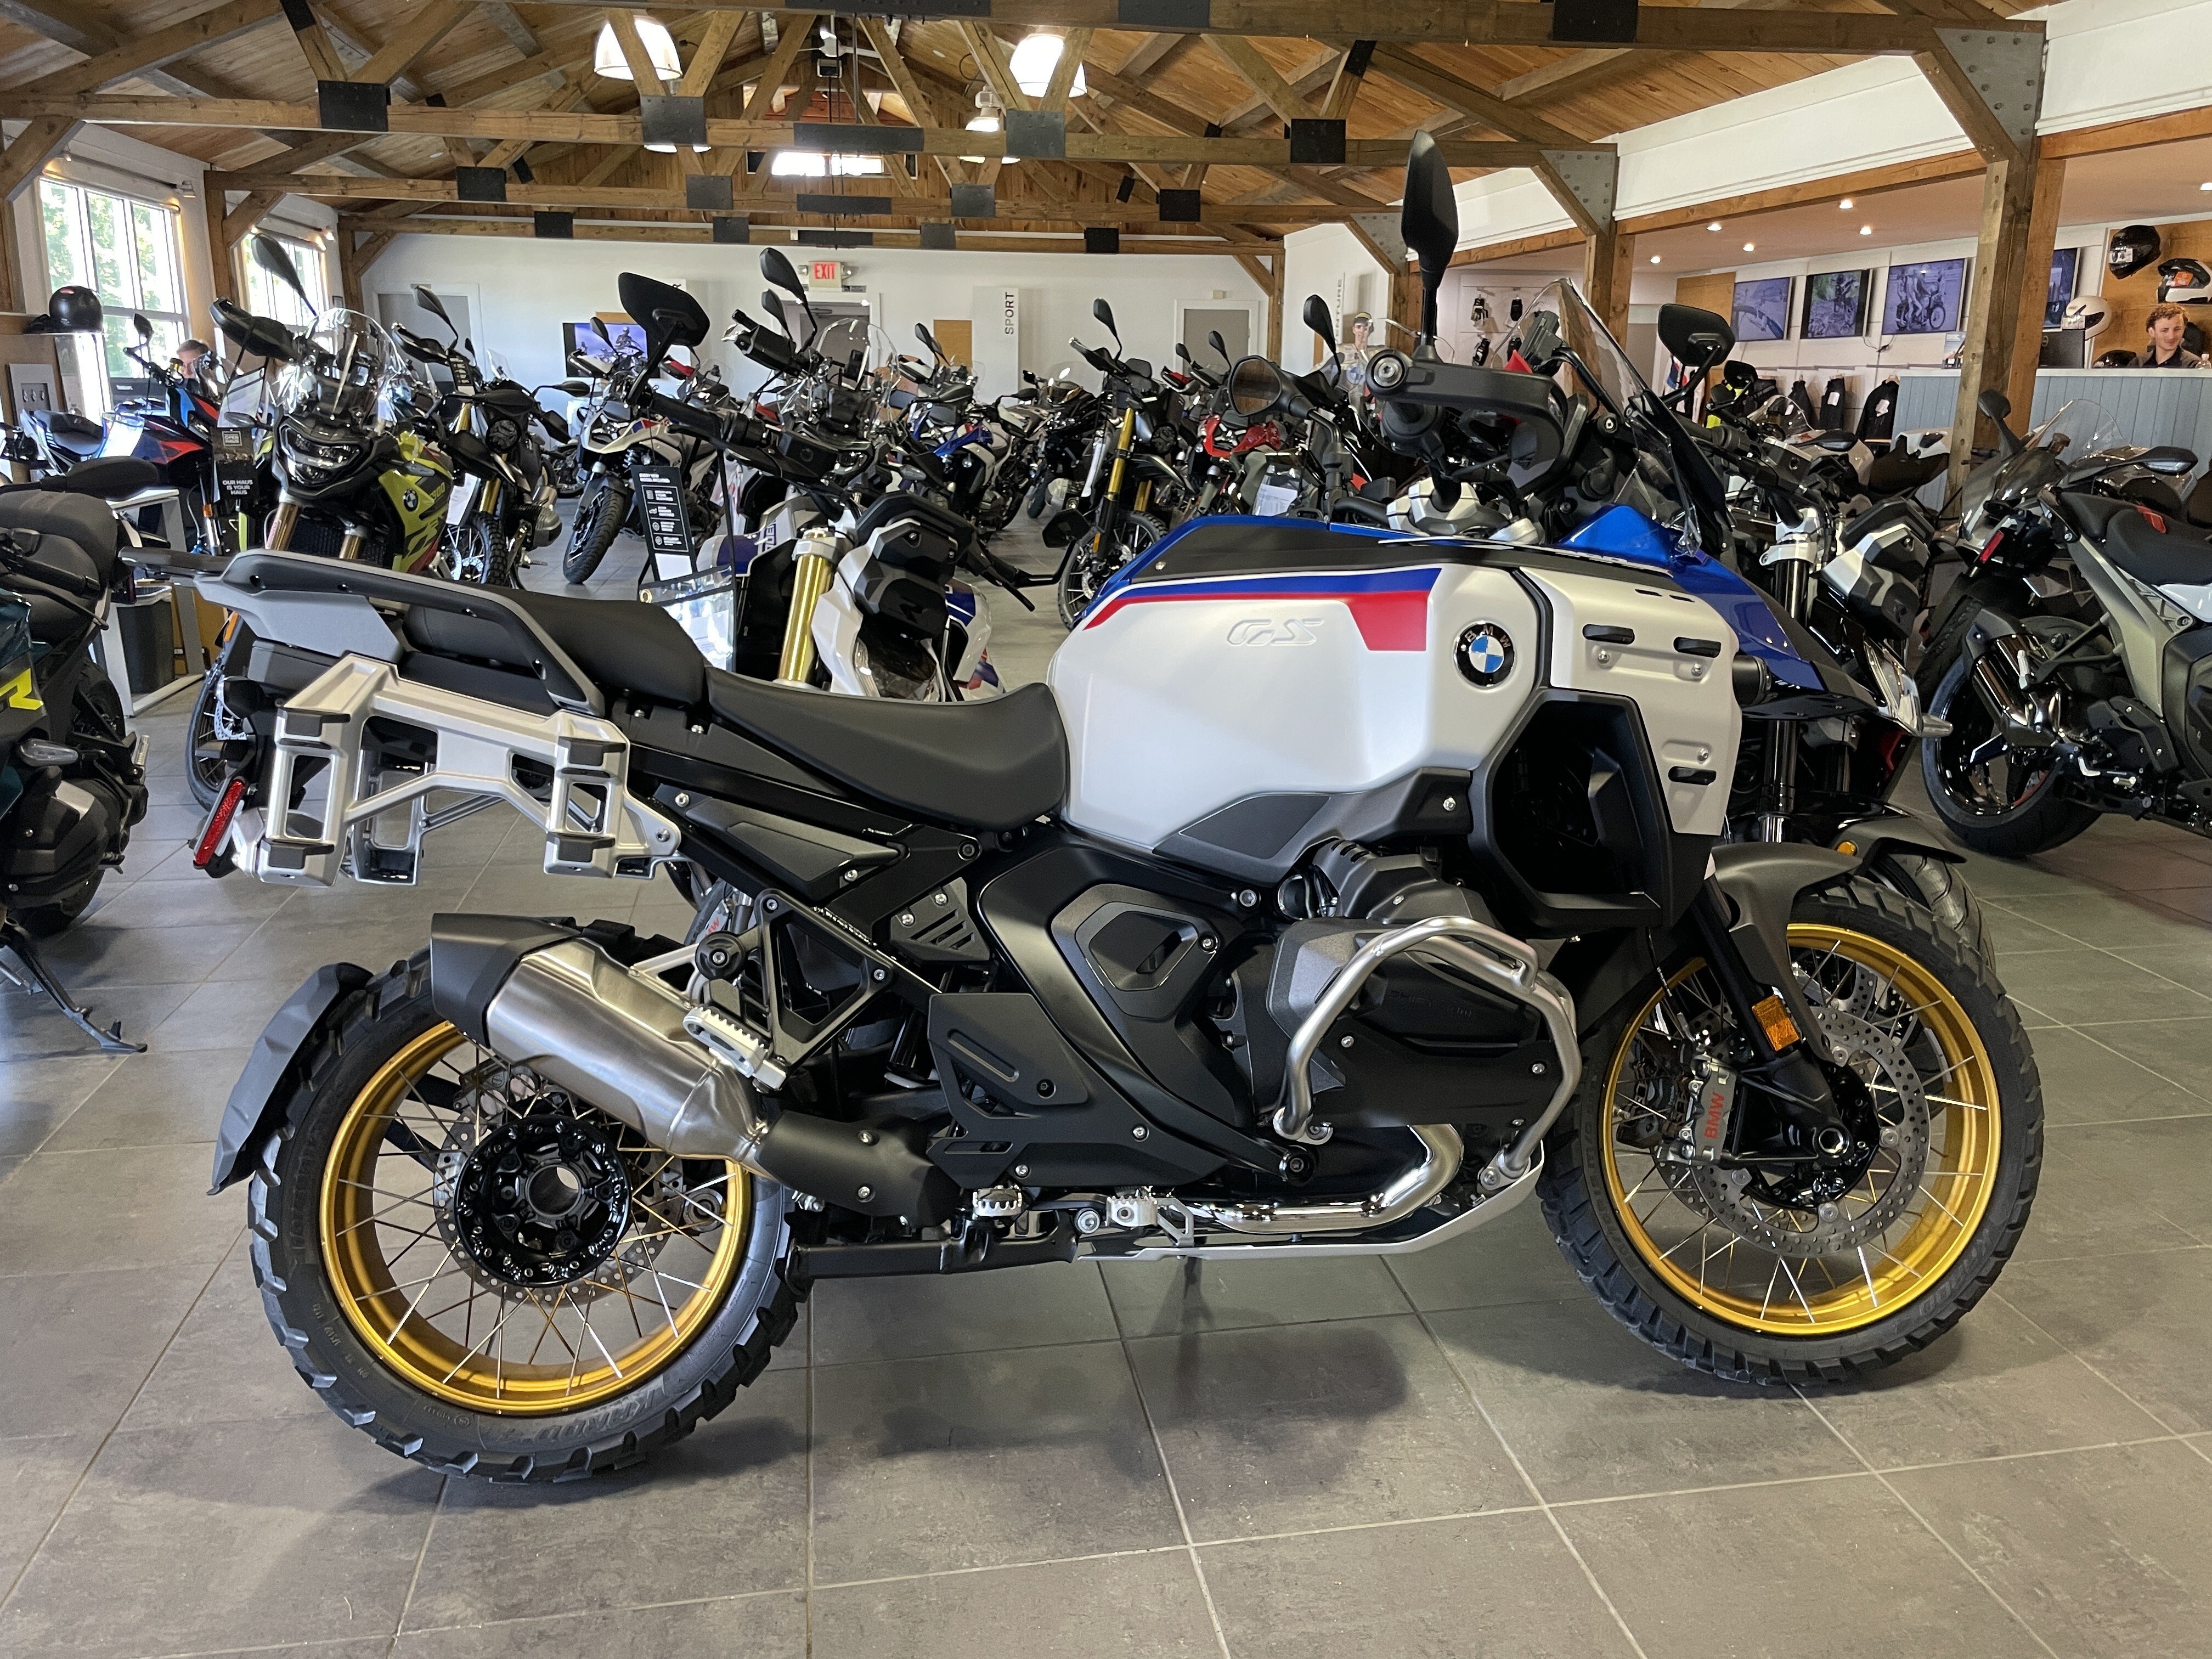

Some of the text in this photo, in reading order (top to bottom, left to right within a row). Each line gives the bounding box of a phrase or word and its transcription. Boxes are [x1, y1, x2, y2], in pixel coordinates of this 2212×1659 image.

[814, 263, 836, 279] EXIT
[1005, 292, 1014, 335] SPORT
[1226, 618, 1324, 647] GS
[1465, 625, 1511, 648] BMW
[1704, 1092, 1725, 1139] BMW
